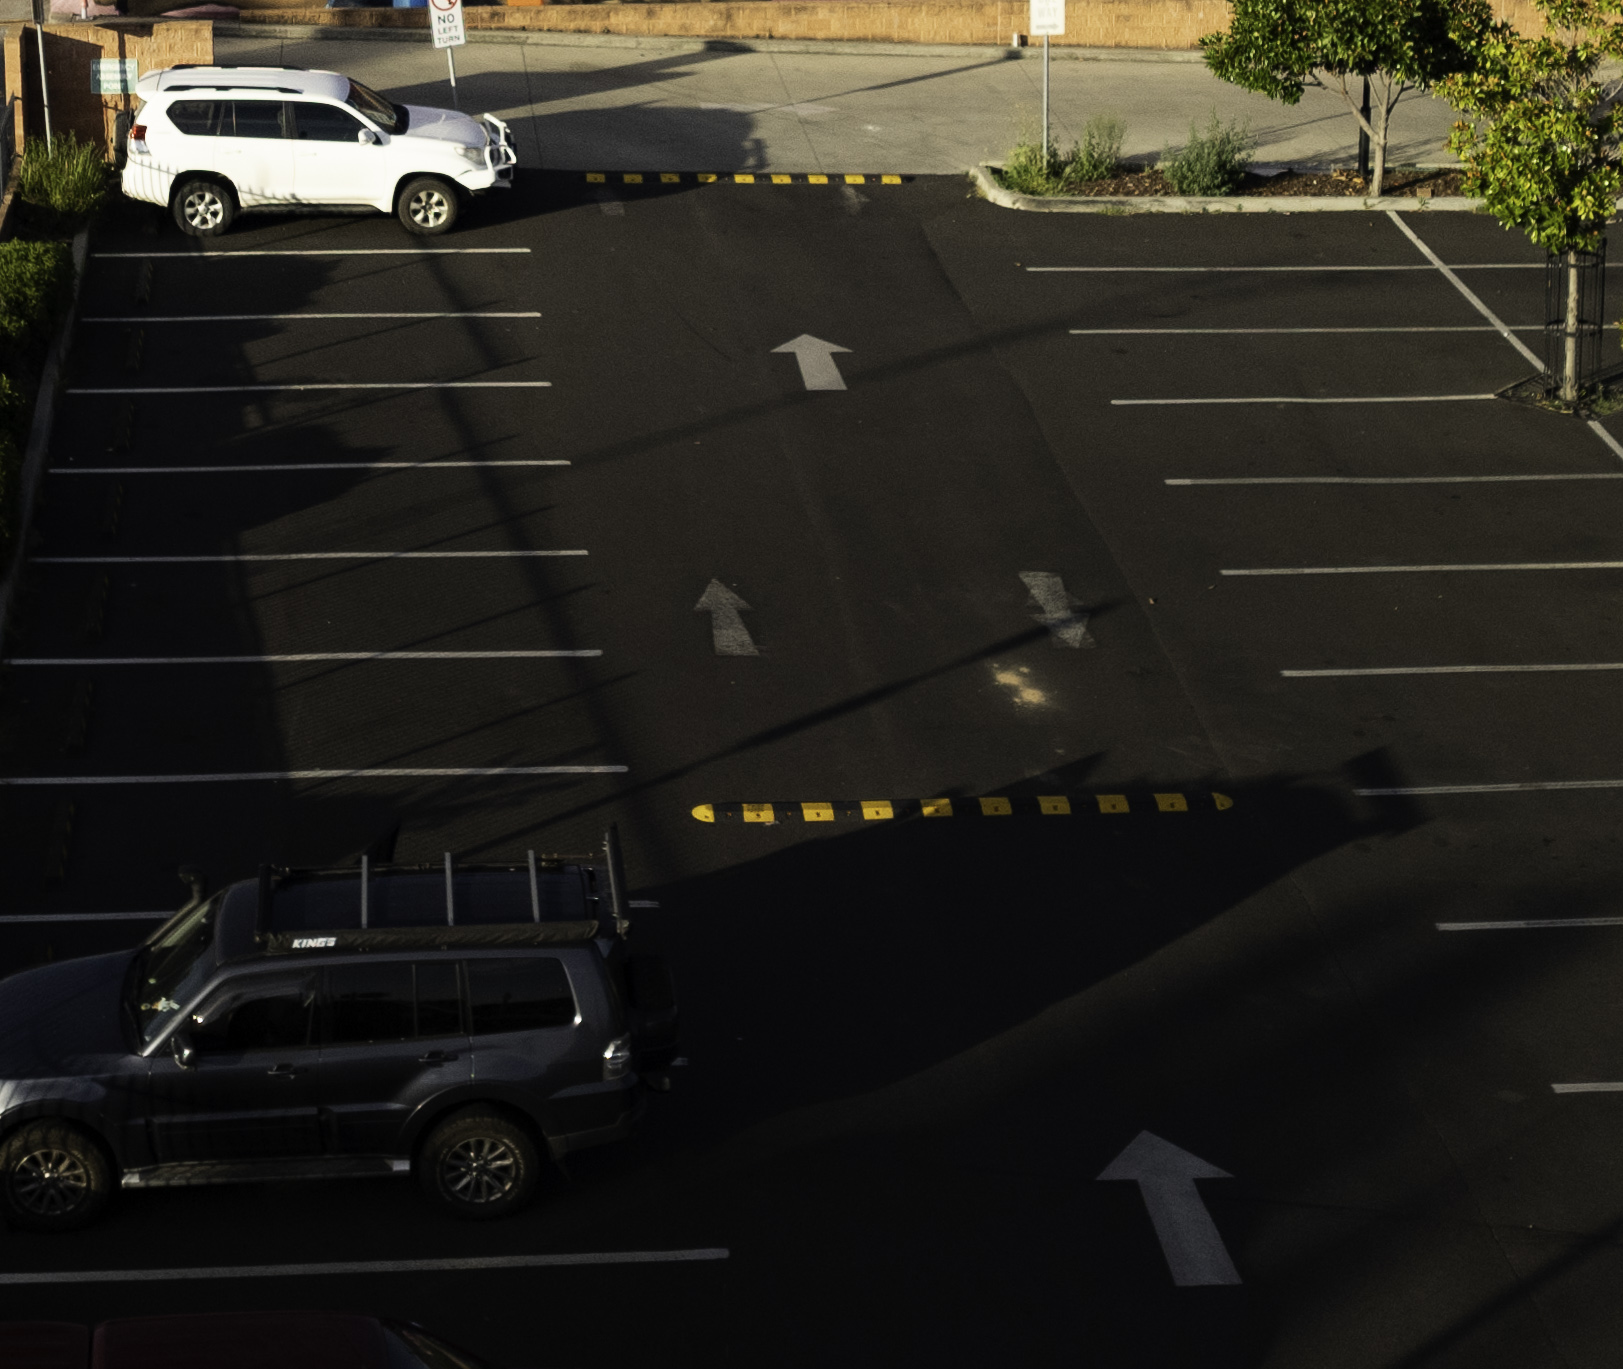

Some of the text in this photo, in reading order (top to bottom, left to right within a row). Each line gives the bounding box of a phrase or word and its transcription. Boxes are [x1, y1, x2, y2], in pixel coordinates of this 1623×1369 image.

[1037, 6, 1058, 18] WAY
[438, 13, 455, 25] NO
[438, 26, 458, 35] LEFT
[437, 35, 460, 44] TURN
[291, 936, 337, 949] KINGS
